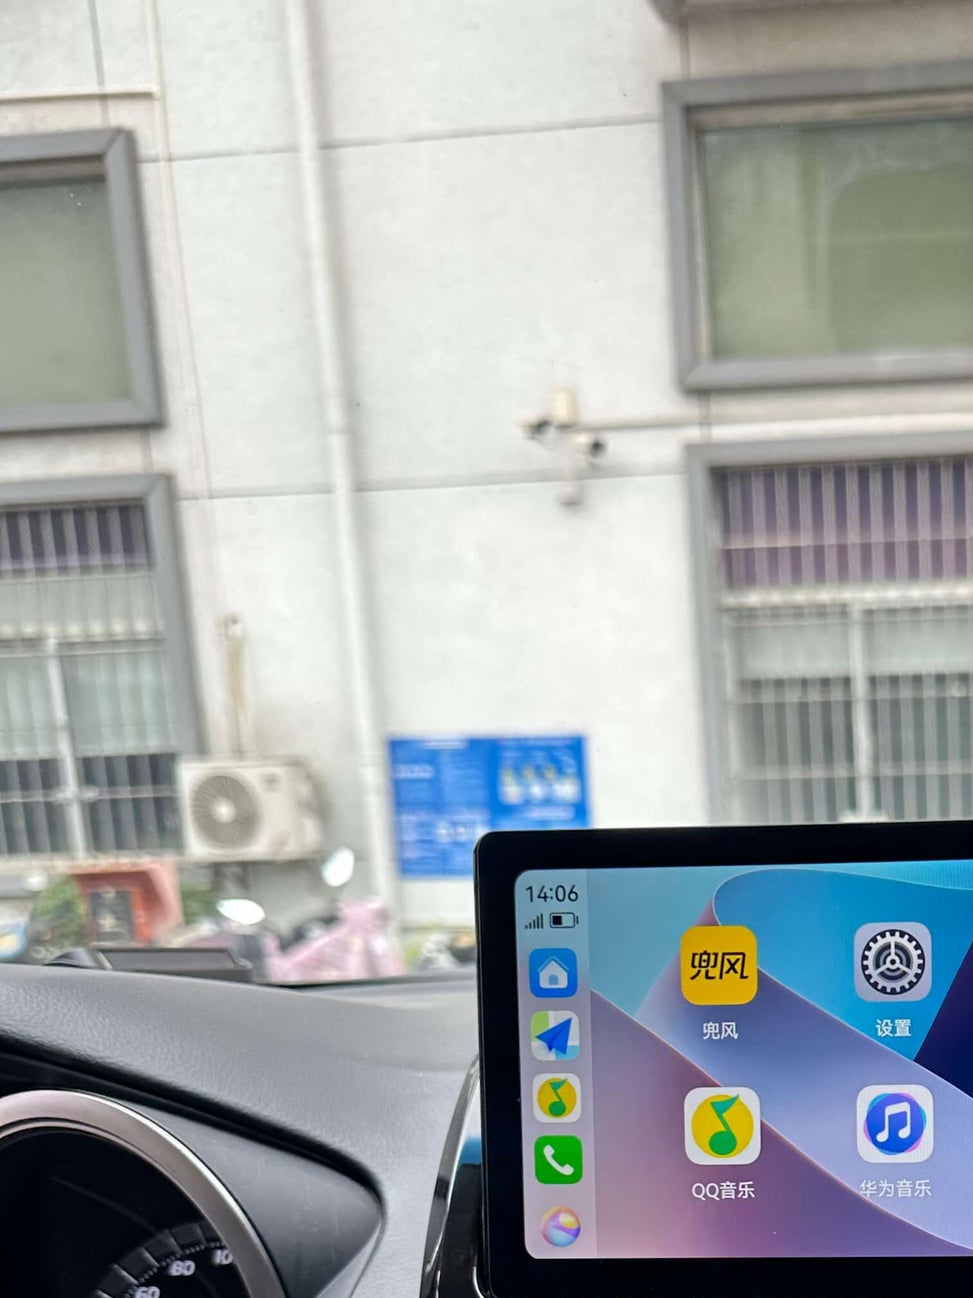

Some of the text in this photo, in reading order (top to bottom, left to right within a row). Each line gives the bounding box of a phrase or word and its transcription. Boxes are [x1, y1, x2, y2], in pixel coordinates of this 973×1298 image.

[525, 885, 579, 904] 14:06
[690, 950, 749, 982] 兜风
[702, 1021, 739, 1040] 兜风
[875, 1019, 912, 1038] 设置
[692, 1181, 755, 1200] QQ音乐
[859, 1179, 932, 1198] 华为音乐
[168, 1259, 195, 1277] 80
